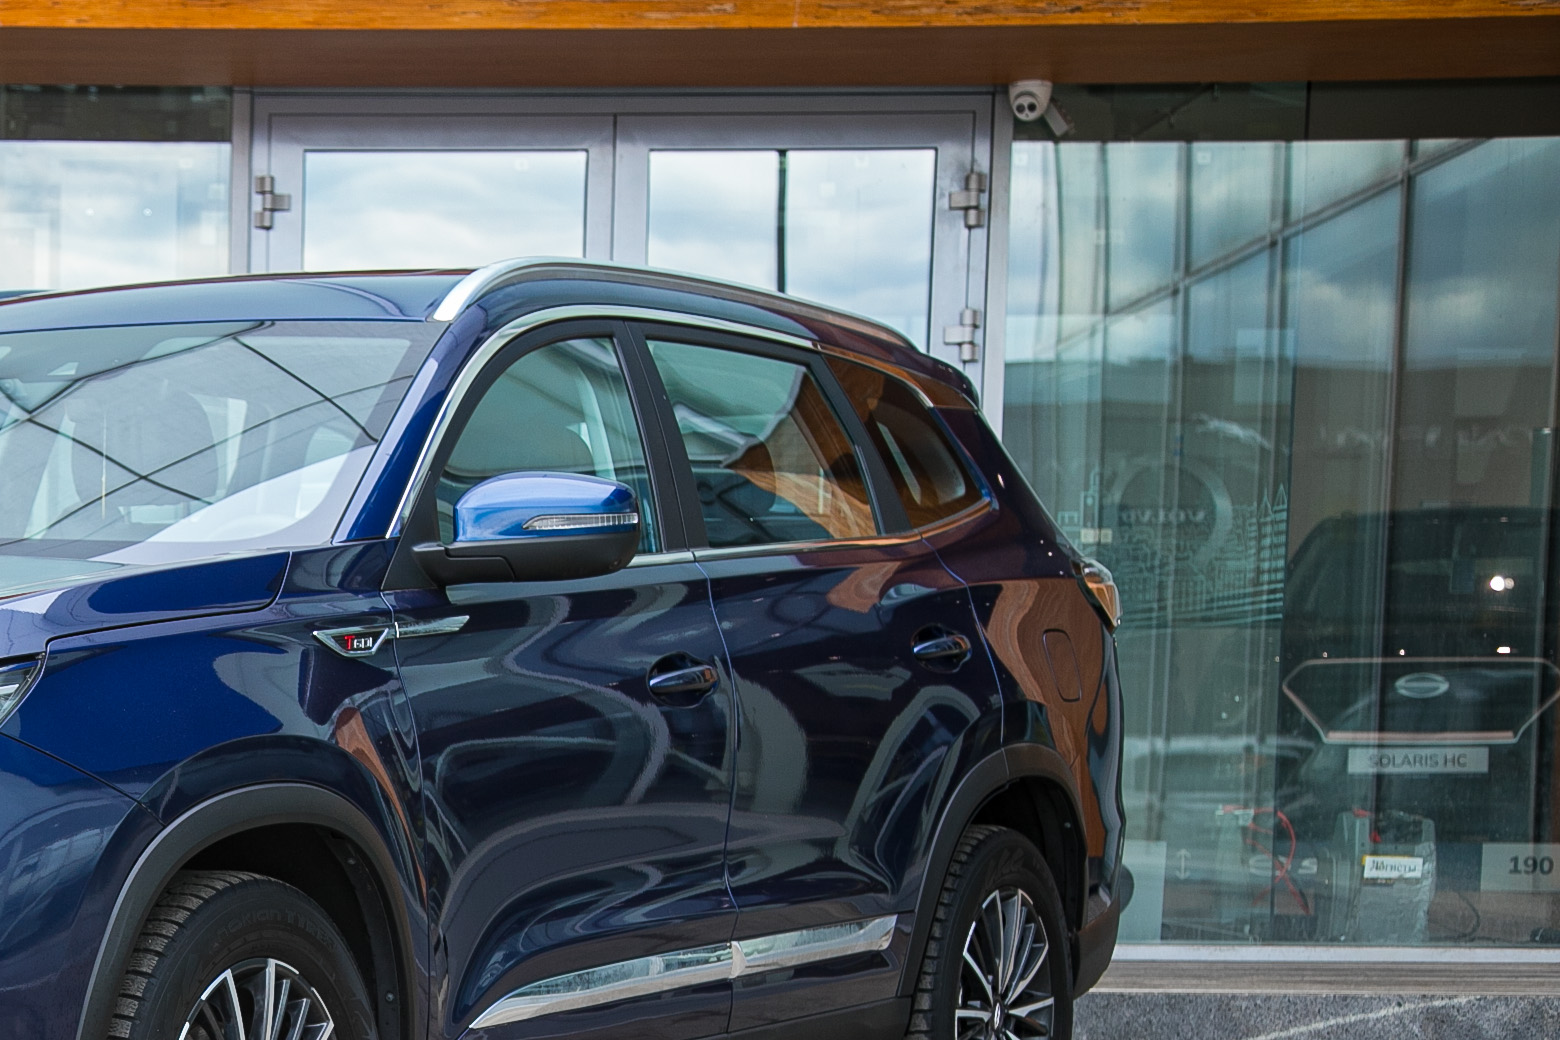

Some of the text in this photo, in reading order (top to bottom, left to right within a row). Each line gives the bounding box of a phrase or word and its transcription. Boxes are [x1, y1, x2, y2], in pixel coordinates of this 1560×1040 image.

[1368, 753, 1468, 769] SOLARIS HC
[1508, 855, 1554, 875] 190
